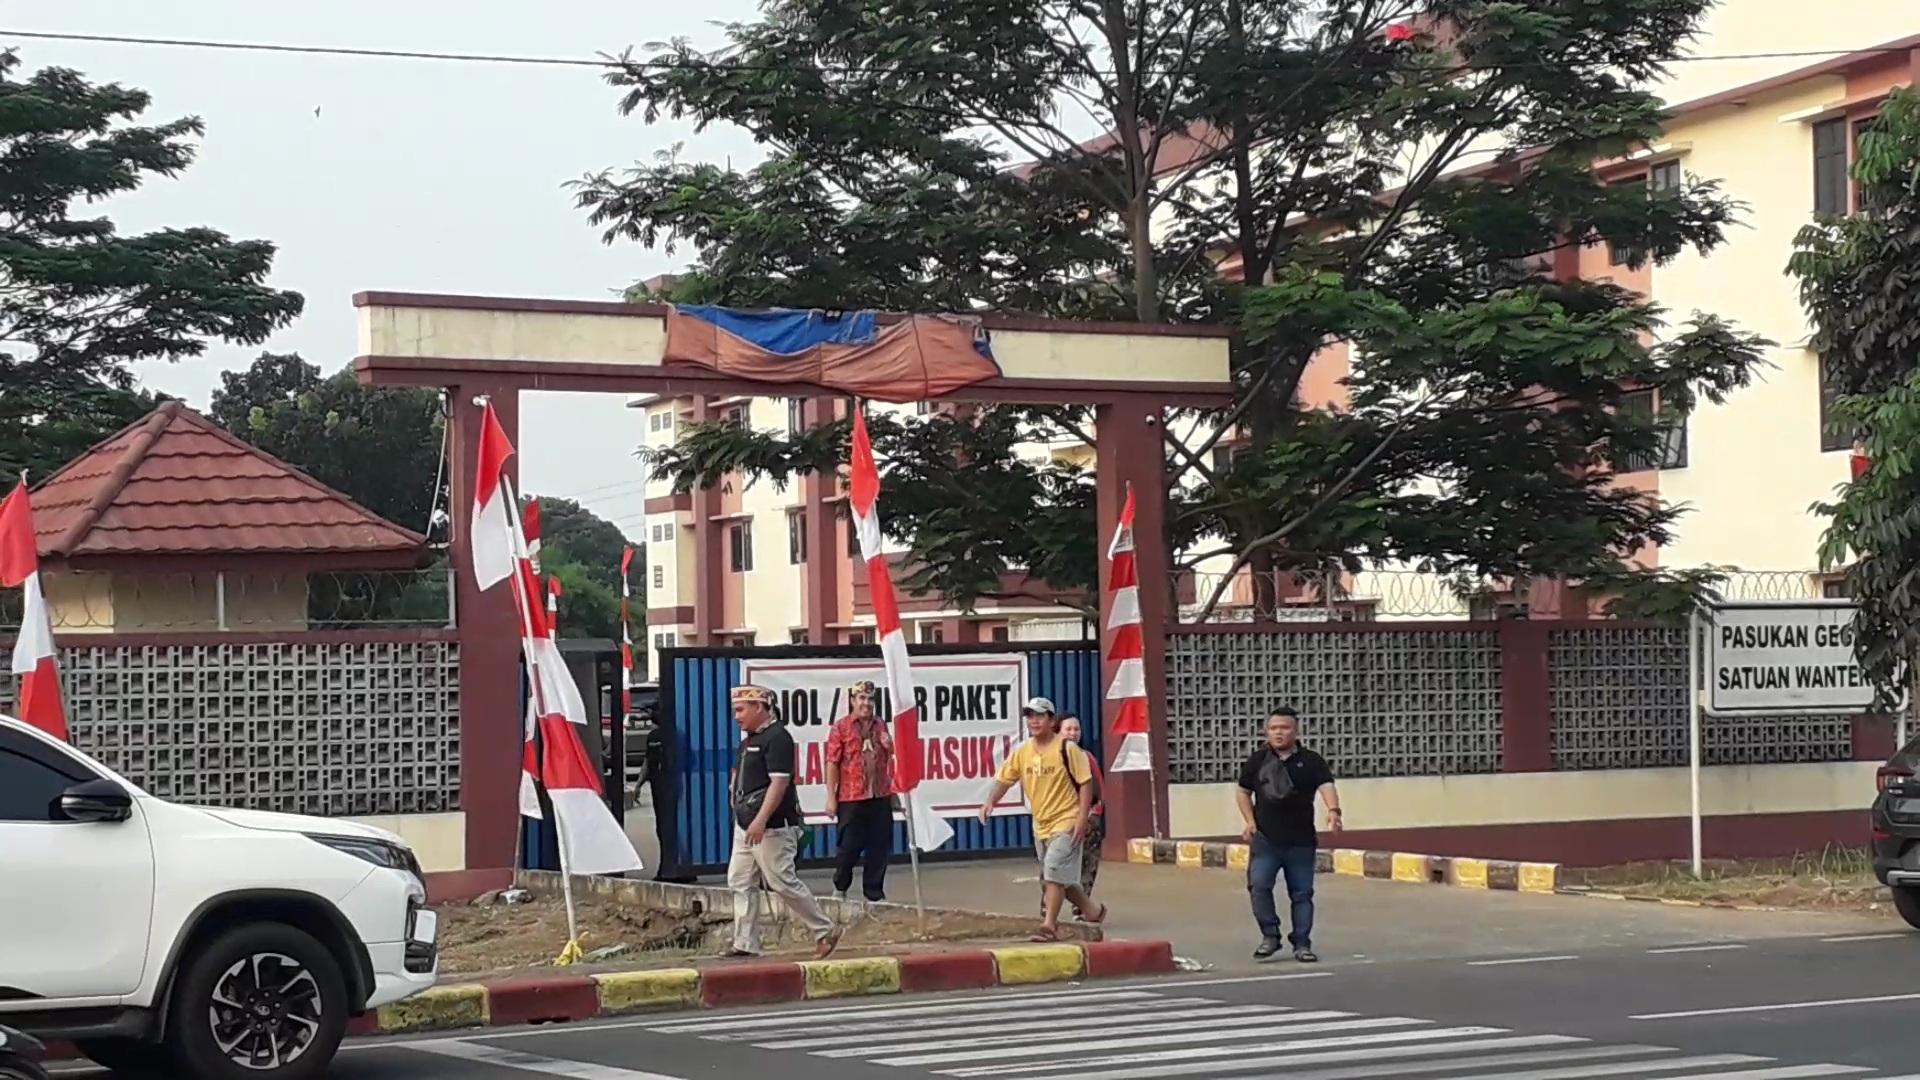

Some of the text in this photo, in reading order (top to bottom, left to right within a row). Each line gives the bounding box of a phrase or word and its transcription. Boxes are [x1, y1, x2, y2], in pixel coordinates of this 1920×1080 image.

[1721, 624, 1854, 648] PASUKAN GEG
[1718, 665, 1870, 690] SATUAN WANTER
[934, 684, 1011, 722] PAKET
